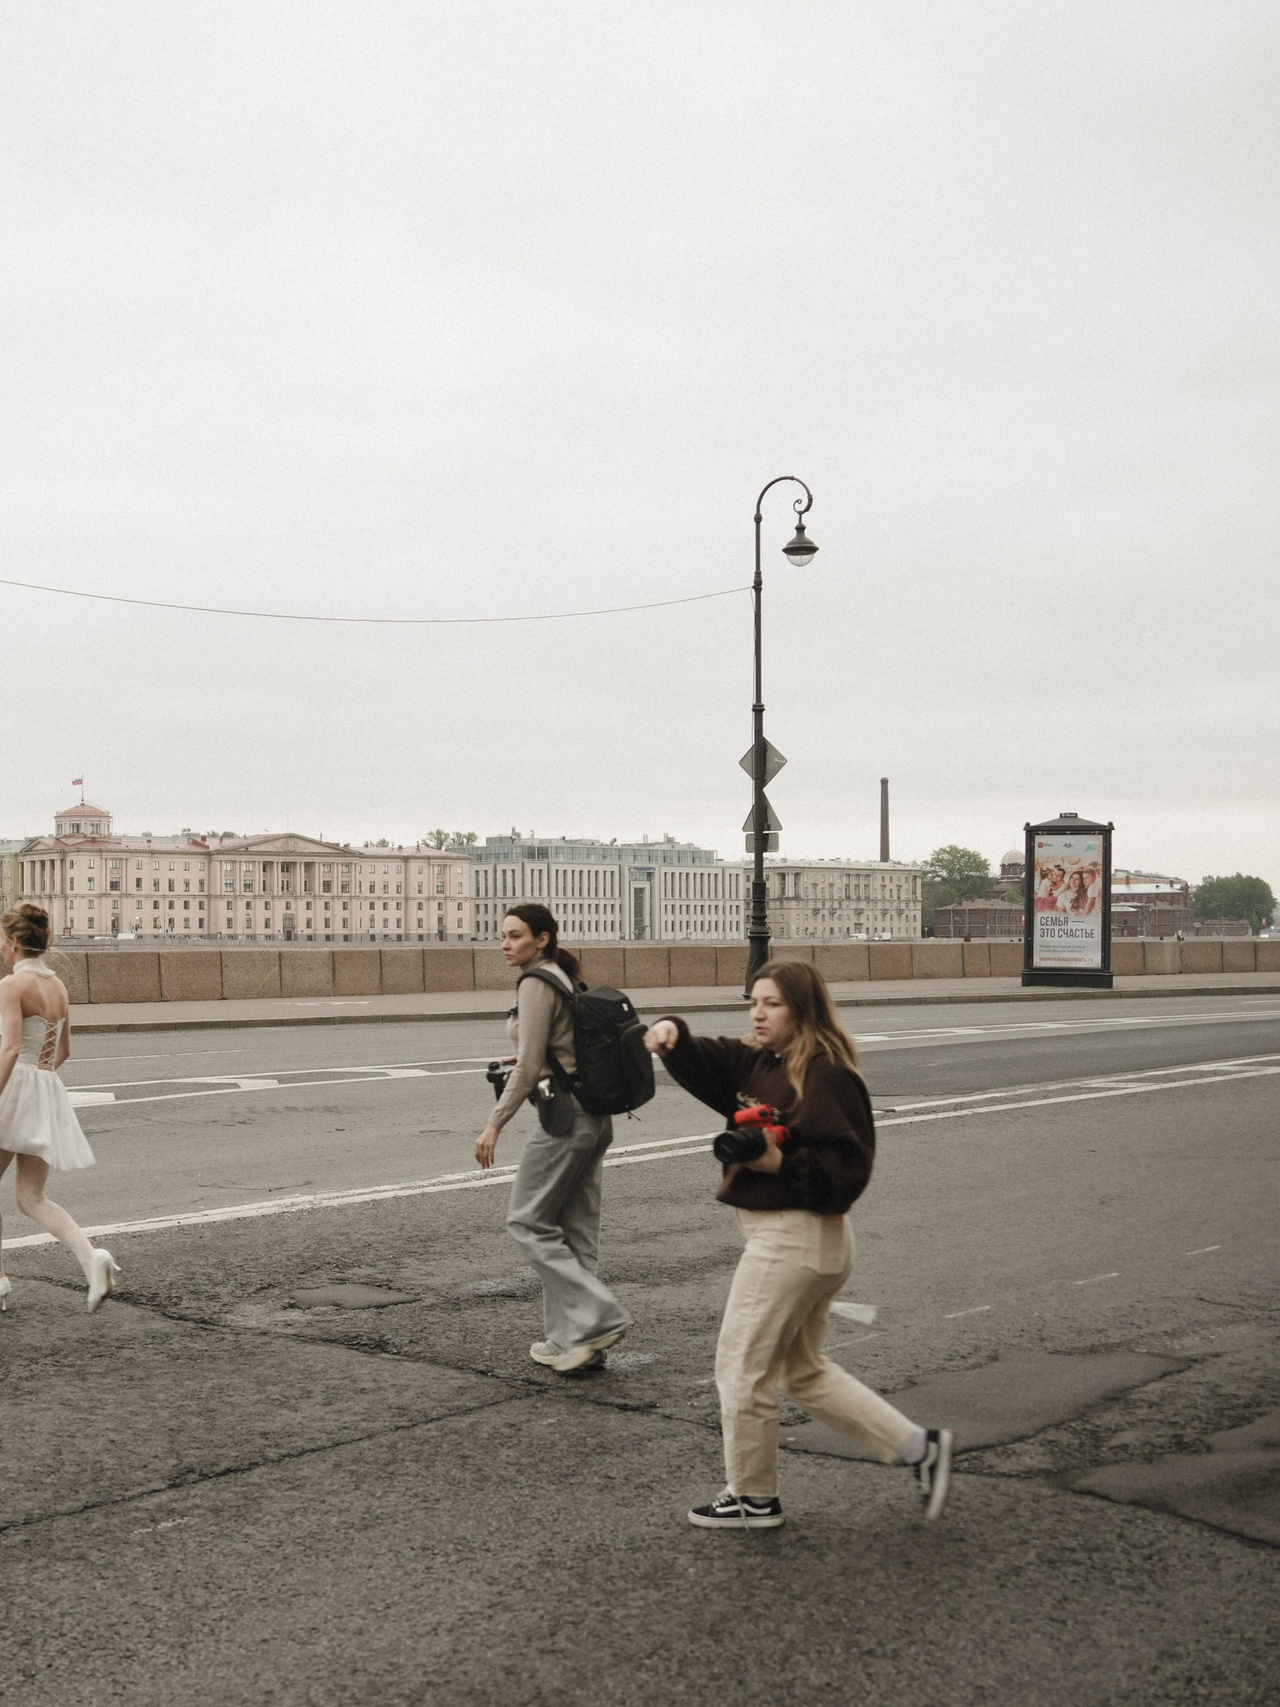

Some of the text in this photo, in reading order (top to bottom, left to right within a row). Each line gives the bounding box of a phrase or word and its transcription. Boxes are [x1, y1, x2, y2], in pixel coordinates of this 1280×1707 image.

[1039, 916, 1069, 926] СЕМЬЯ
[1039, 928, 1096, 939] ЭТО СЧАСТЬЕ
